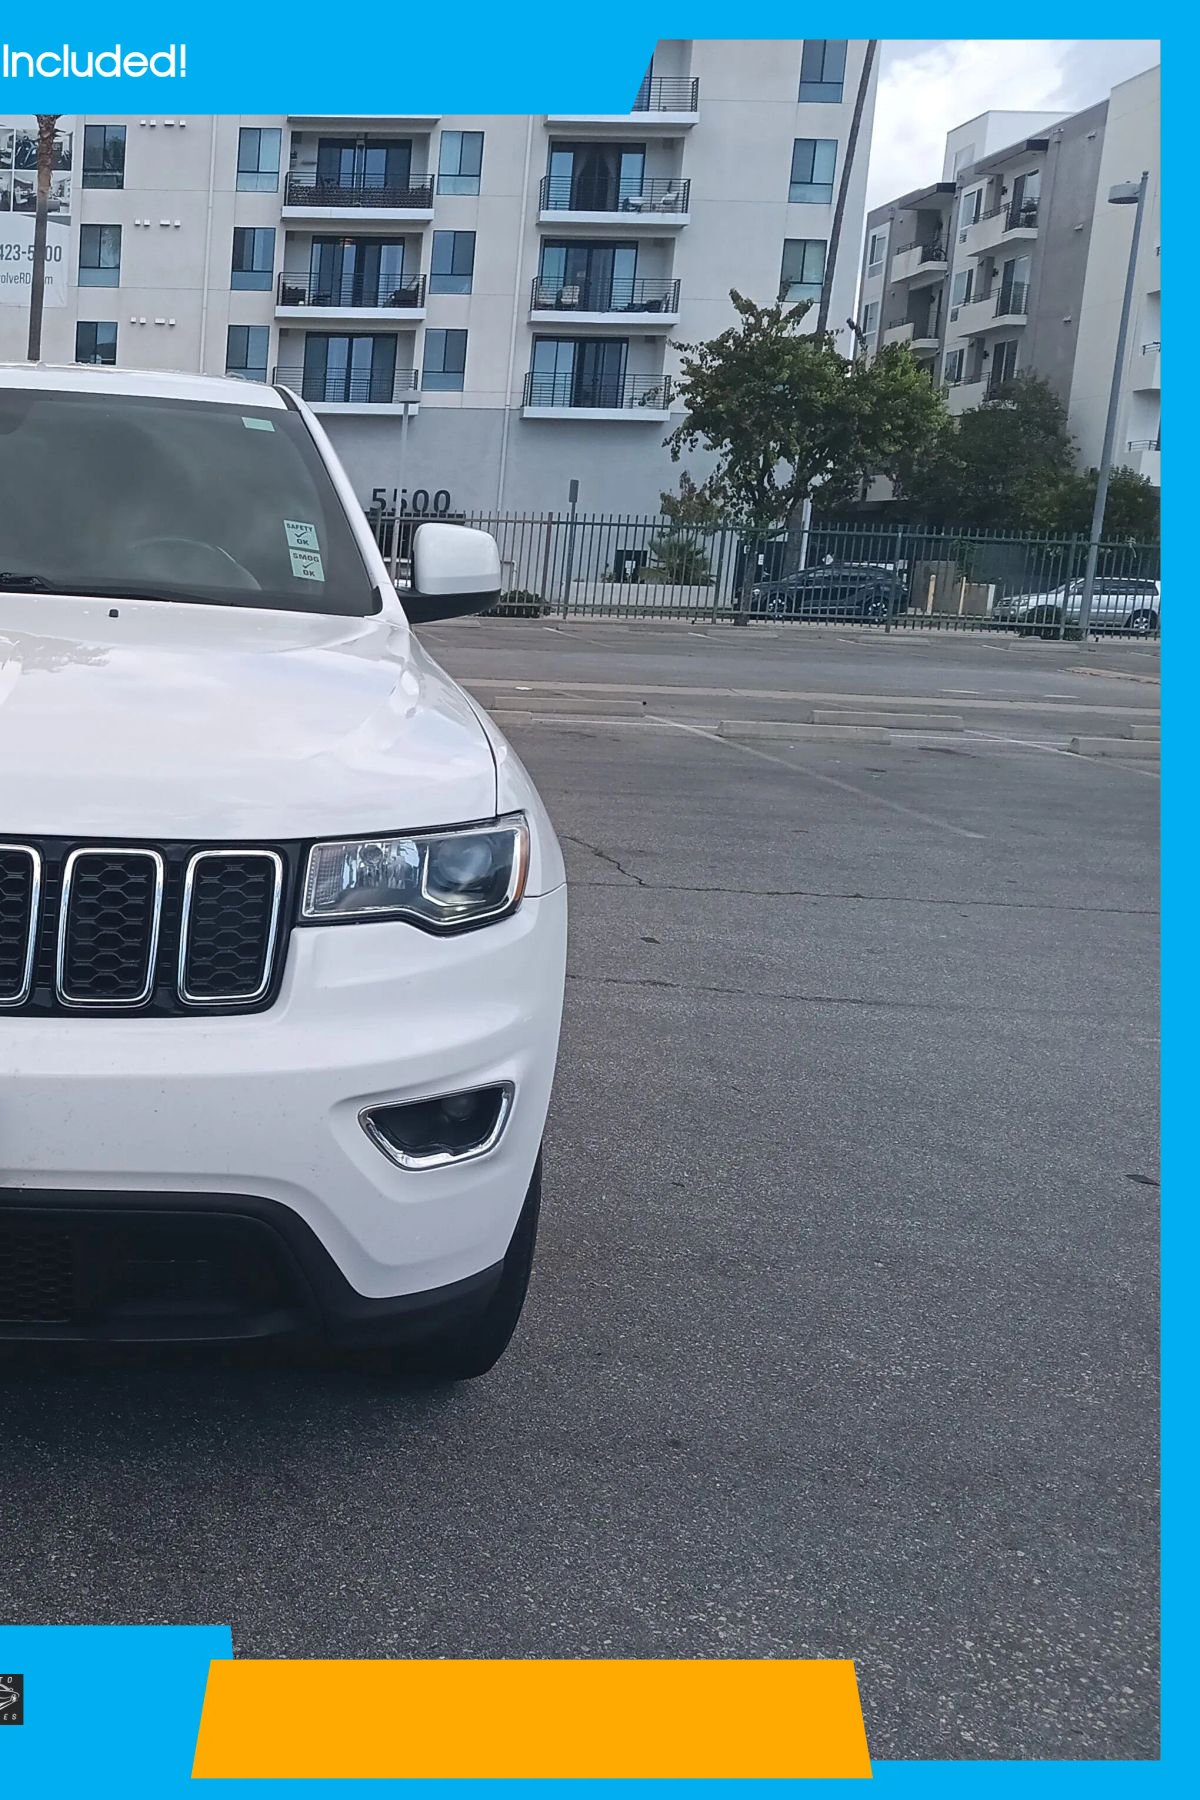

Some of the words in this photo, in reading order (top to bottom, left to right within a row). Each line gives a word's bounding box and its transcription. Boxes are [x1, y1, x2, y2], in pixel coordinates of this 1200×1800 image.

[286, 523, 313, 532] SAFETY
[296, 538, 310, 546] OK
[292, 552, 320, 563] SMOG
[302, 569, 316, 577] OK
